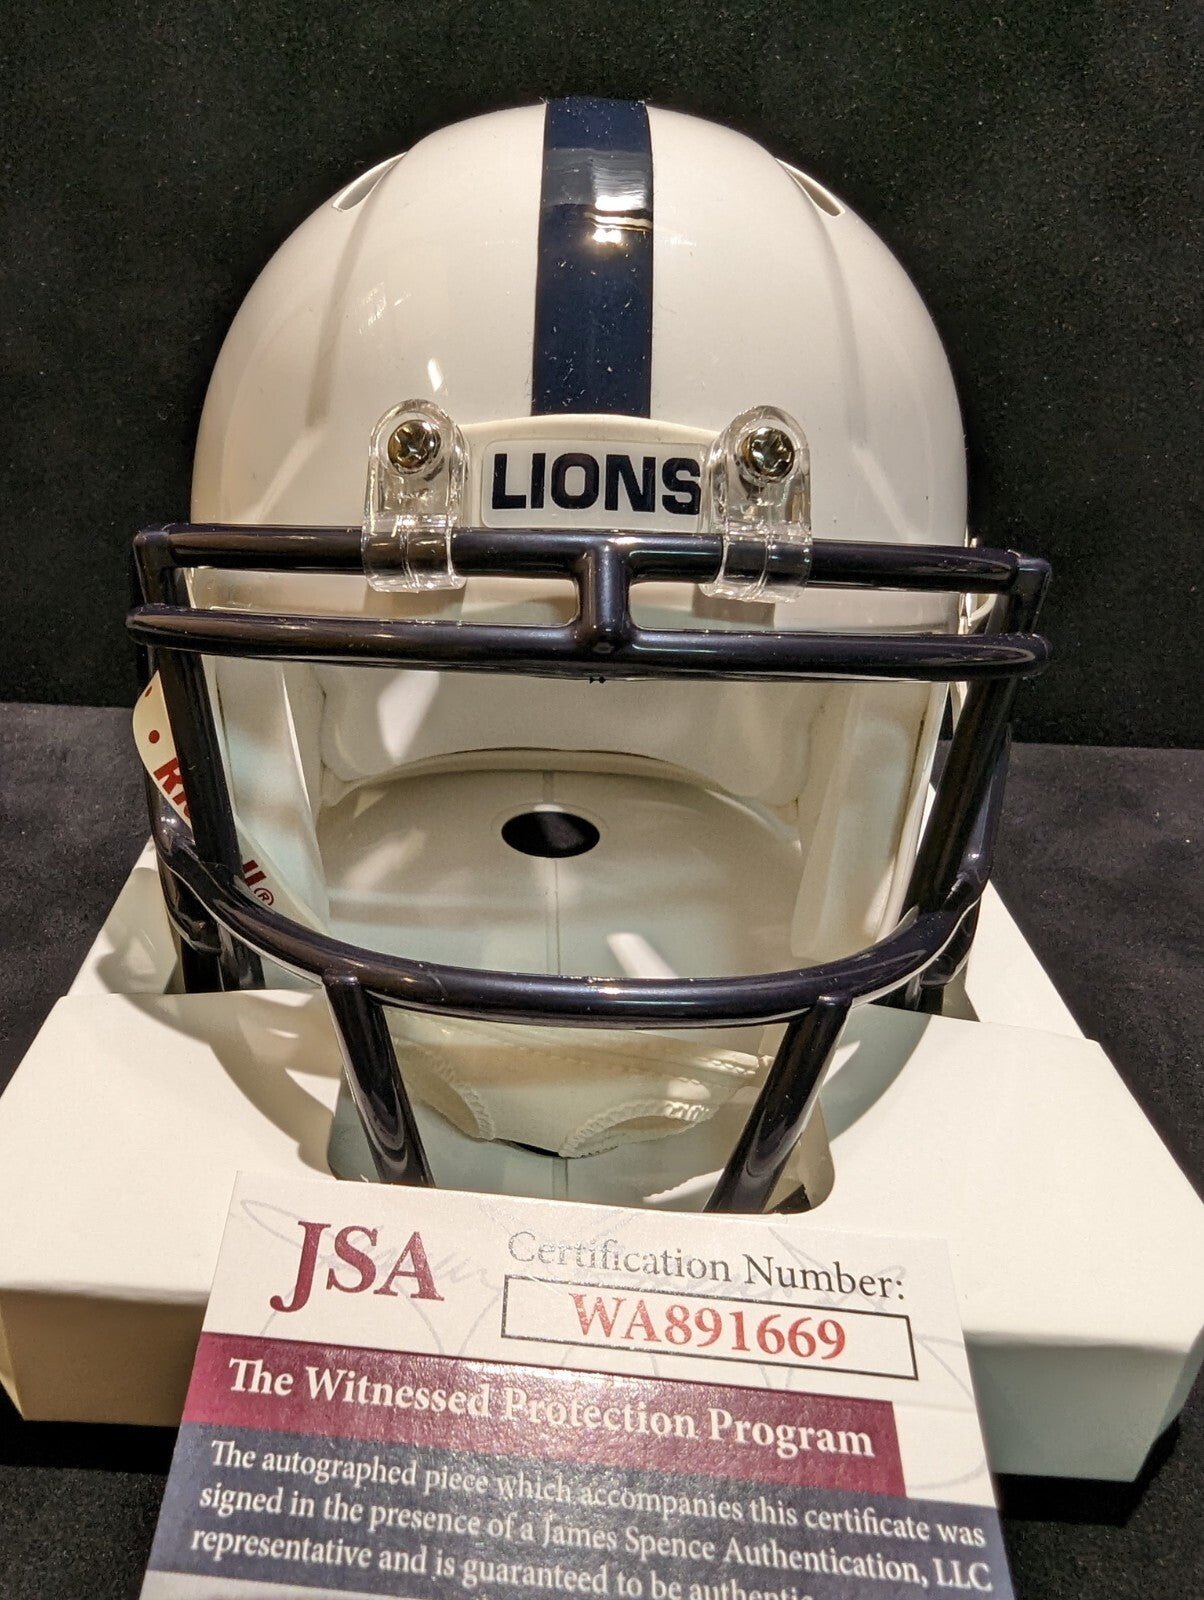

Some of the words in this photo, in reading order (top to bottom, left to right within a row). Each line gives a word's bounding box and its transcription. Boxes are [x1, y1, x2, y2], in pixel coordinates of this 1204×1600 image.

[491, 452, 701, 514] LIONS
[270, 1221, 444, 1312] JSA
[507, 1231, 731, 1283] Certification
[742, 1254, 905, 1300] Number:
[568, 1293, 846, 1361] WA891669
[228, 1357, 293, 1397] The
[305, 1366, 490, 1418] Witnessed
[505, 1386, 698, 1440] Protection
[708, 1409, 876, 1458] Program
[211, 1440, 256, 1468] The
[262, 1453, 417, 1486] autographed
[424, 1466, 488, 1495] piece
[497, 1472, 570, 1503] which
[579, 1488, 743, 1523] accompanies
[750, 1496, 797, 1526] this
[804, 1507, 931, 1542] certificate
[938, 1523, 985, 1548] was
[190, 1528, 372, 1567] representative
[379, 1544, 427, 1575] and
[435, 1551, 455, 1577] is
[462, 1557, 608, 1595] guaranteed
[617, 1570, 643, 1598] to
[650, 1570, 682, 1600] be
[200, 1484, 284, 1515] signed
[291, 1490, 313, 1517] in
[322, 1495, 361, 1522] the
[368, 1507, 480, 1536] presence
[487, 1510, 520, 1537] of
[521, 1520, 534, 1542] a
[542, 1512, 617, 1550] James
[625, 1528, 715, 1563] Spence
[723, 1537, 928, 1588] Authentication,
[932, 1558, 993, 1592] LLC
